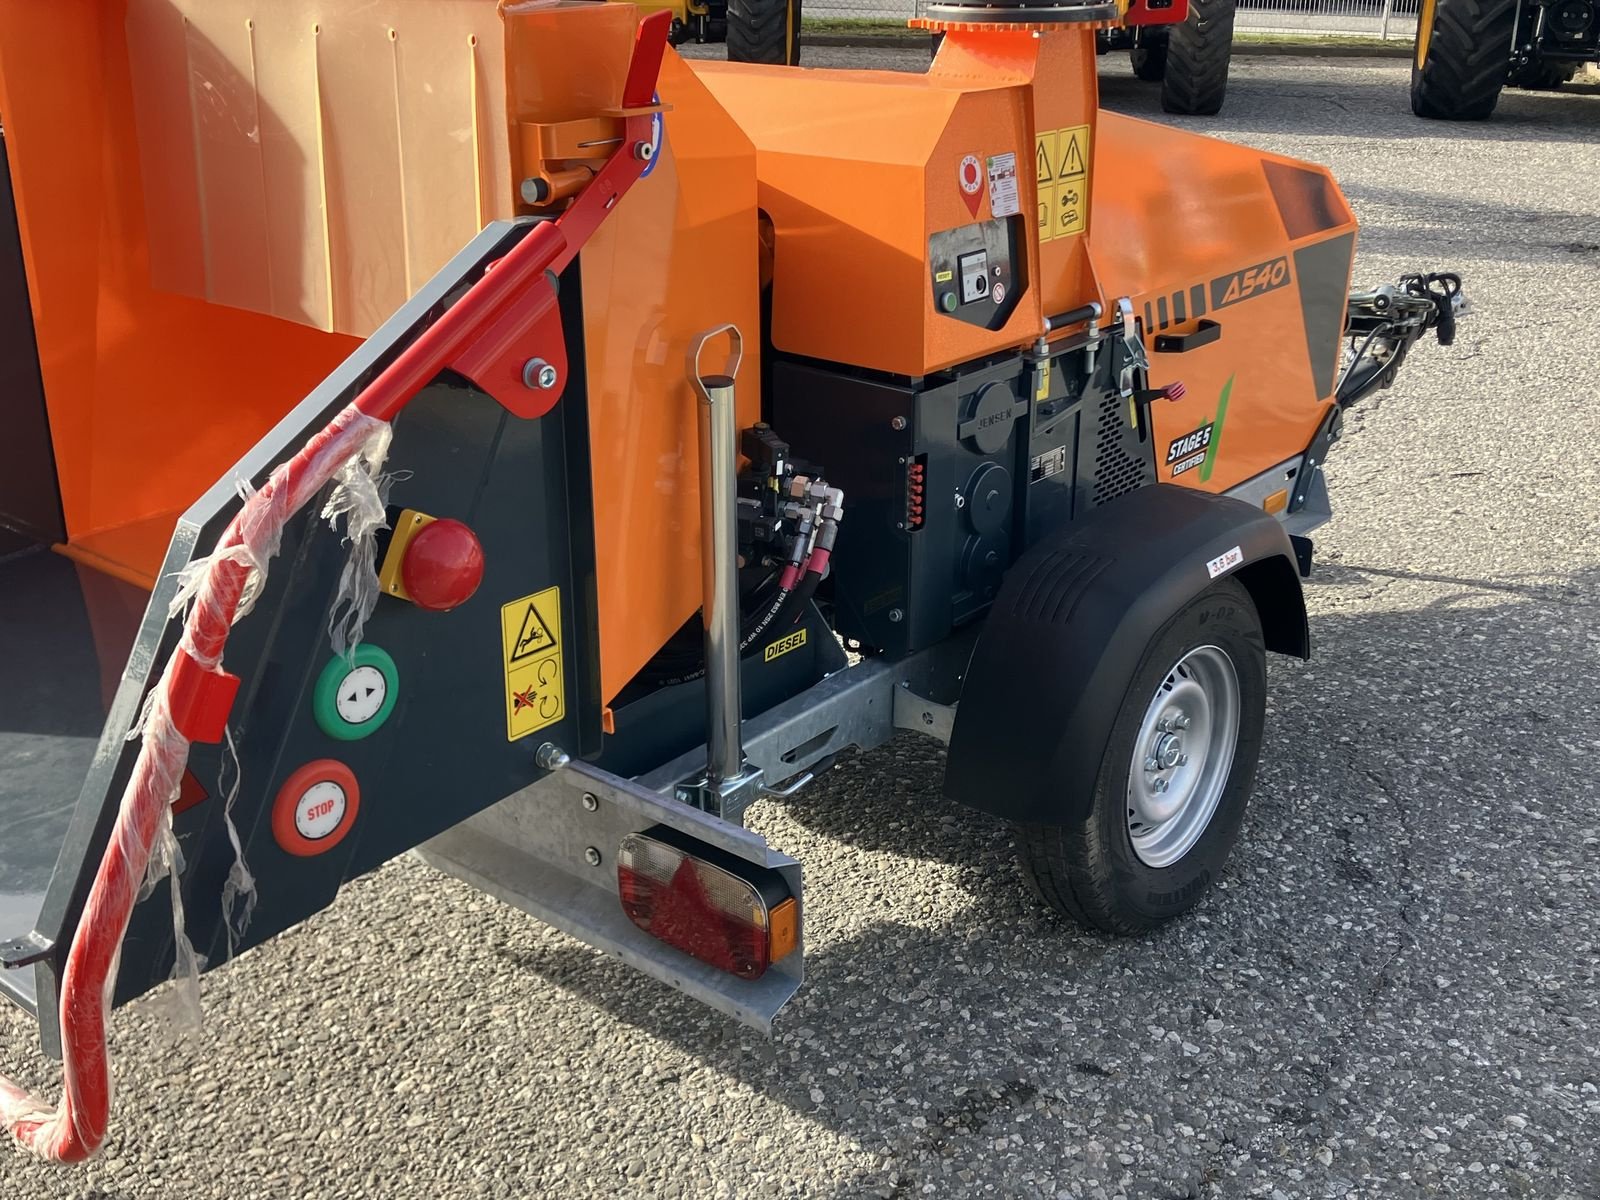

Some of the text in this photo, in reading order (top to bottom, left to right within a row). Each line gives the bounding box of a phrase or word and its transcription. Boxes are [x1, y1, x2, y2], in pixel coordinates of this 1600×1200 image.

[1220, 259, 1287, 305] A540
[977, 408, 1012, 430] JENSEN
[1167, 426, 1212, 461] STAGE 5
[1224, 552, 1238, 566] bar
[779, 591, 788, 603] EN
[755, 624, 764, 634] 10
[767, 632, 805, 660] DIESEL
[306, 799, 335, 822] STOP
